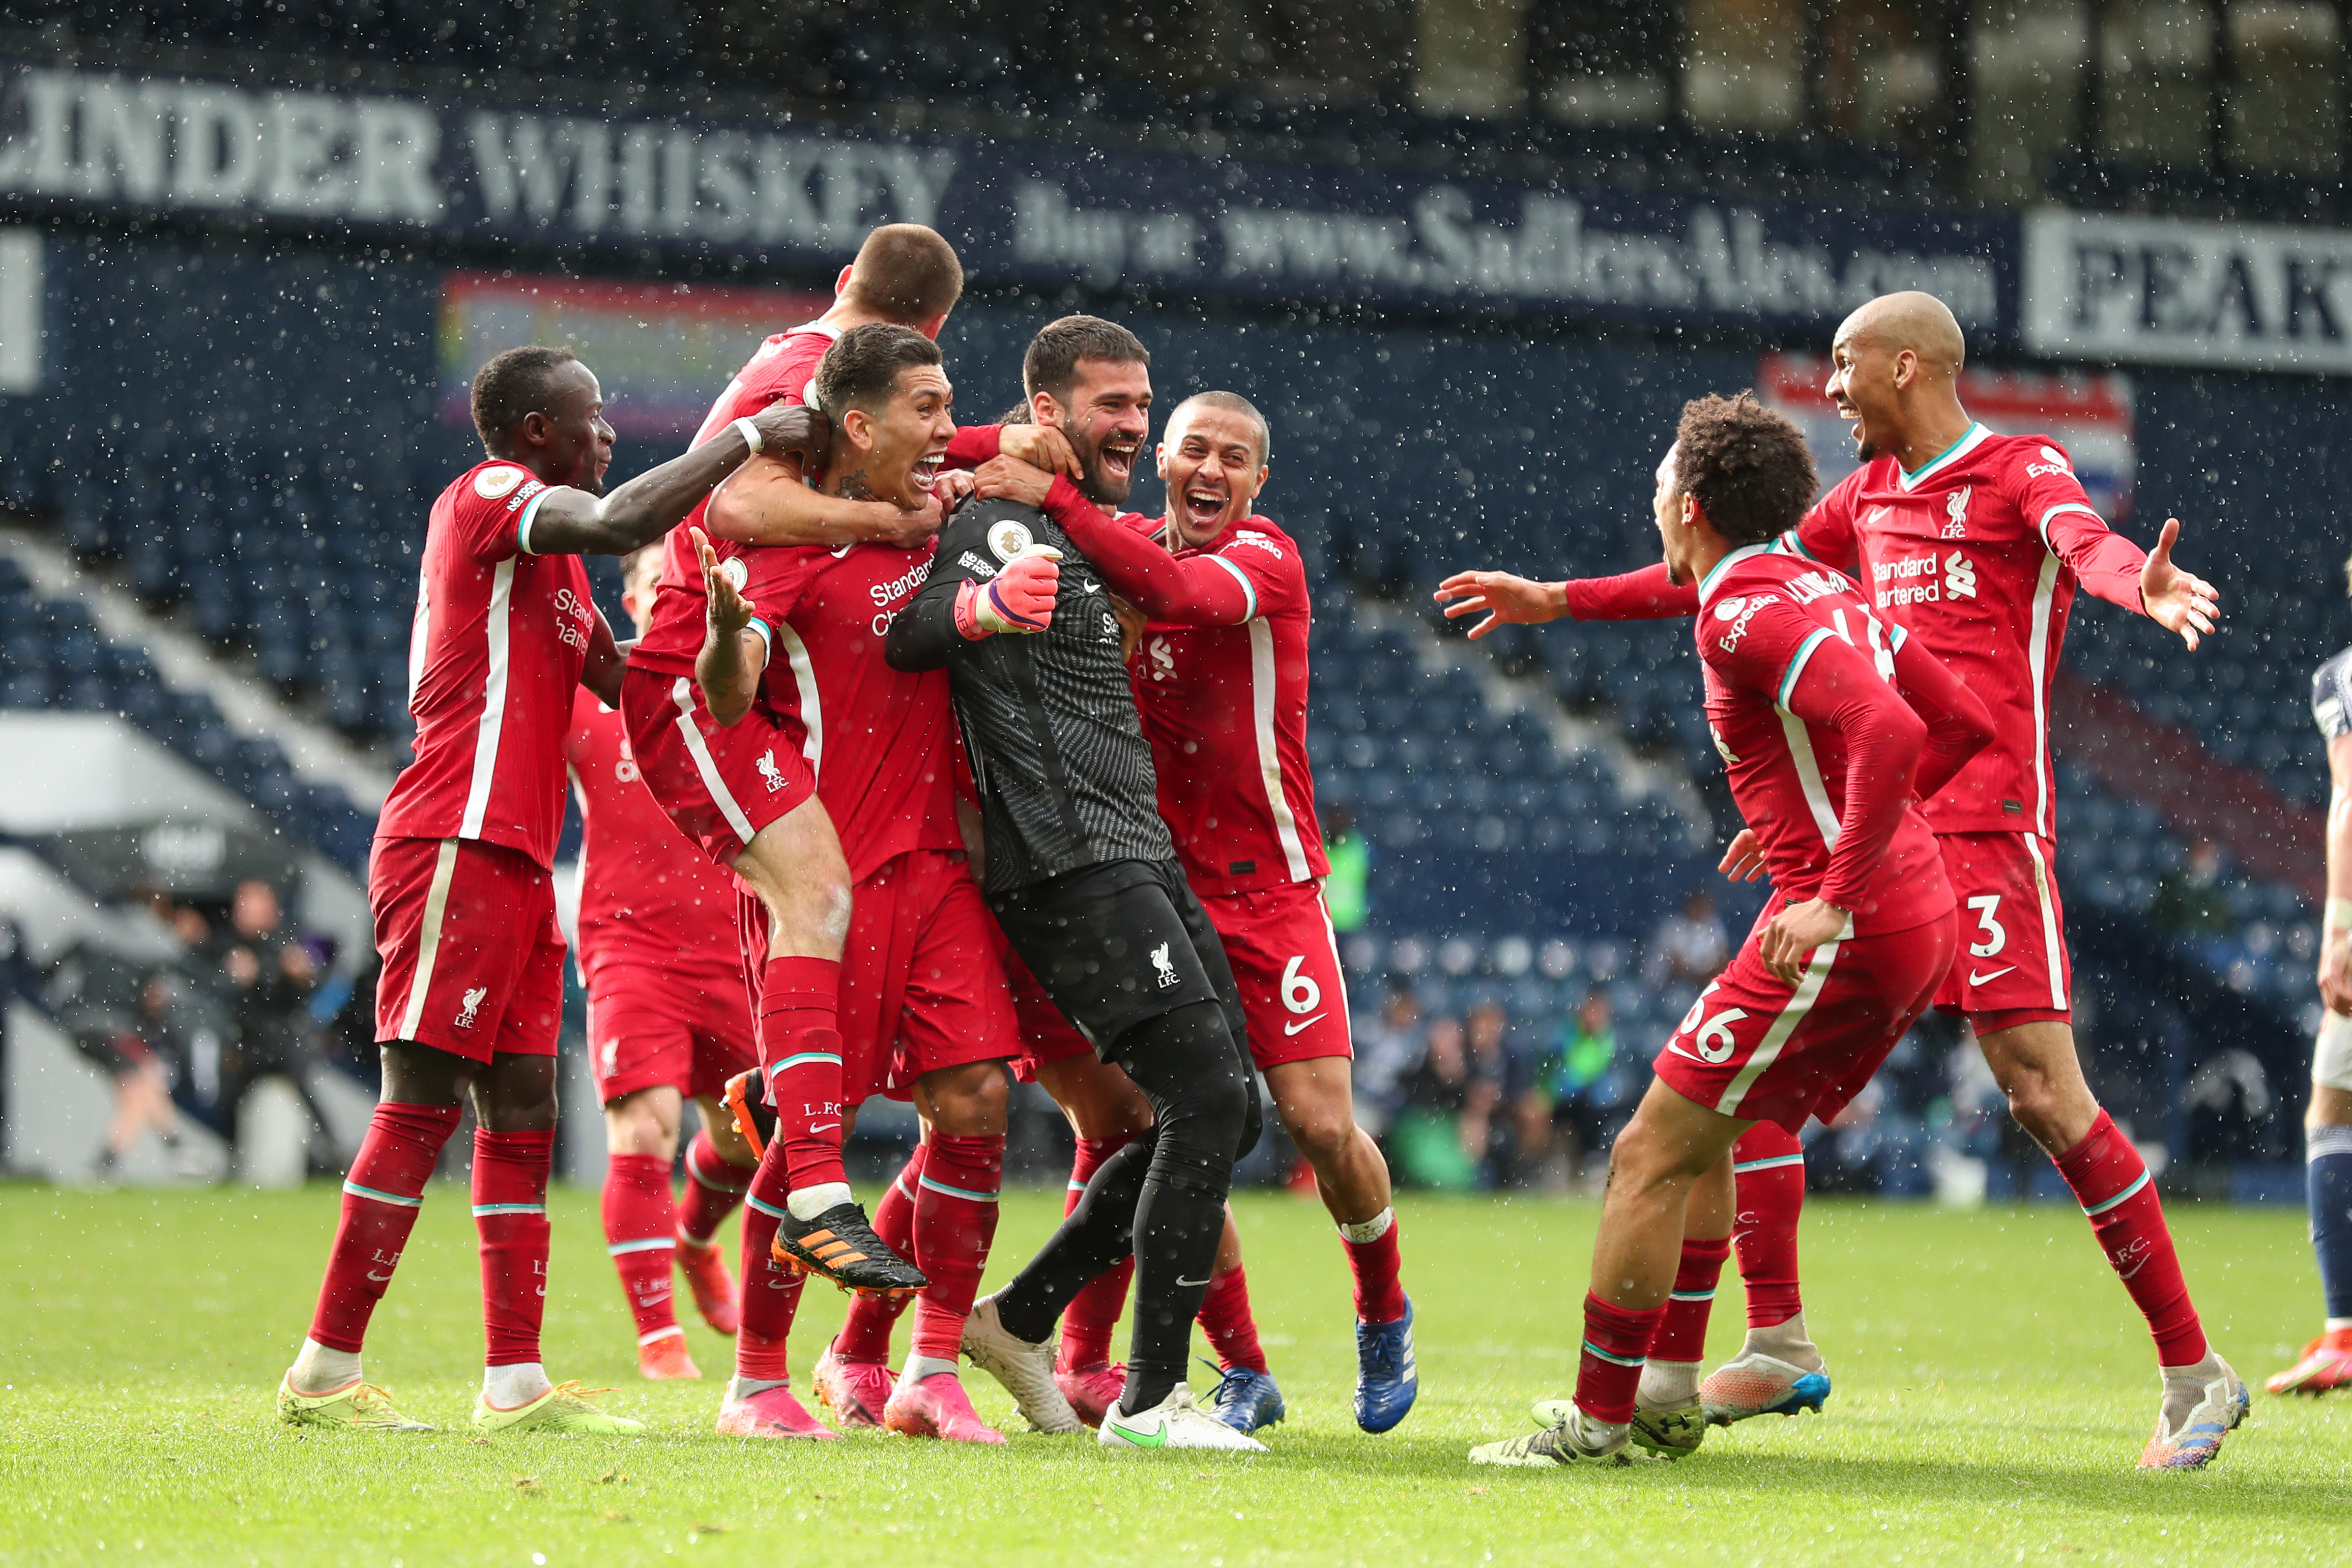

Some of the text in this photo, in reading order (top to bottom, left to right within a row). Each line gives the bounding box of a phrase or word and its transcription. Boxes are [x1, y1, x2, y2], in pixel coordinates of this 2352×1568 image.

[467, 108, 962, 254] WHISKEY
[2070, 235, 2352, 347] PEAK
[1872, 552, 1937, 584] Standard
[1719, 595, 1780, 654] Expedia
[766, 777, 790, 793] L.F.C.
[1967, 895, 2006, 957] 3
[1157, 974, 1181, 989] L.F.C.
[1281, 955, 1321, 1014] 6
[1680, 982, 1749, 1064] 66
